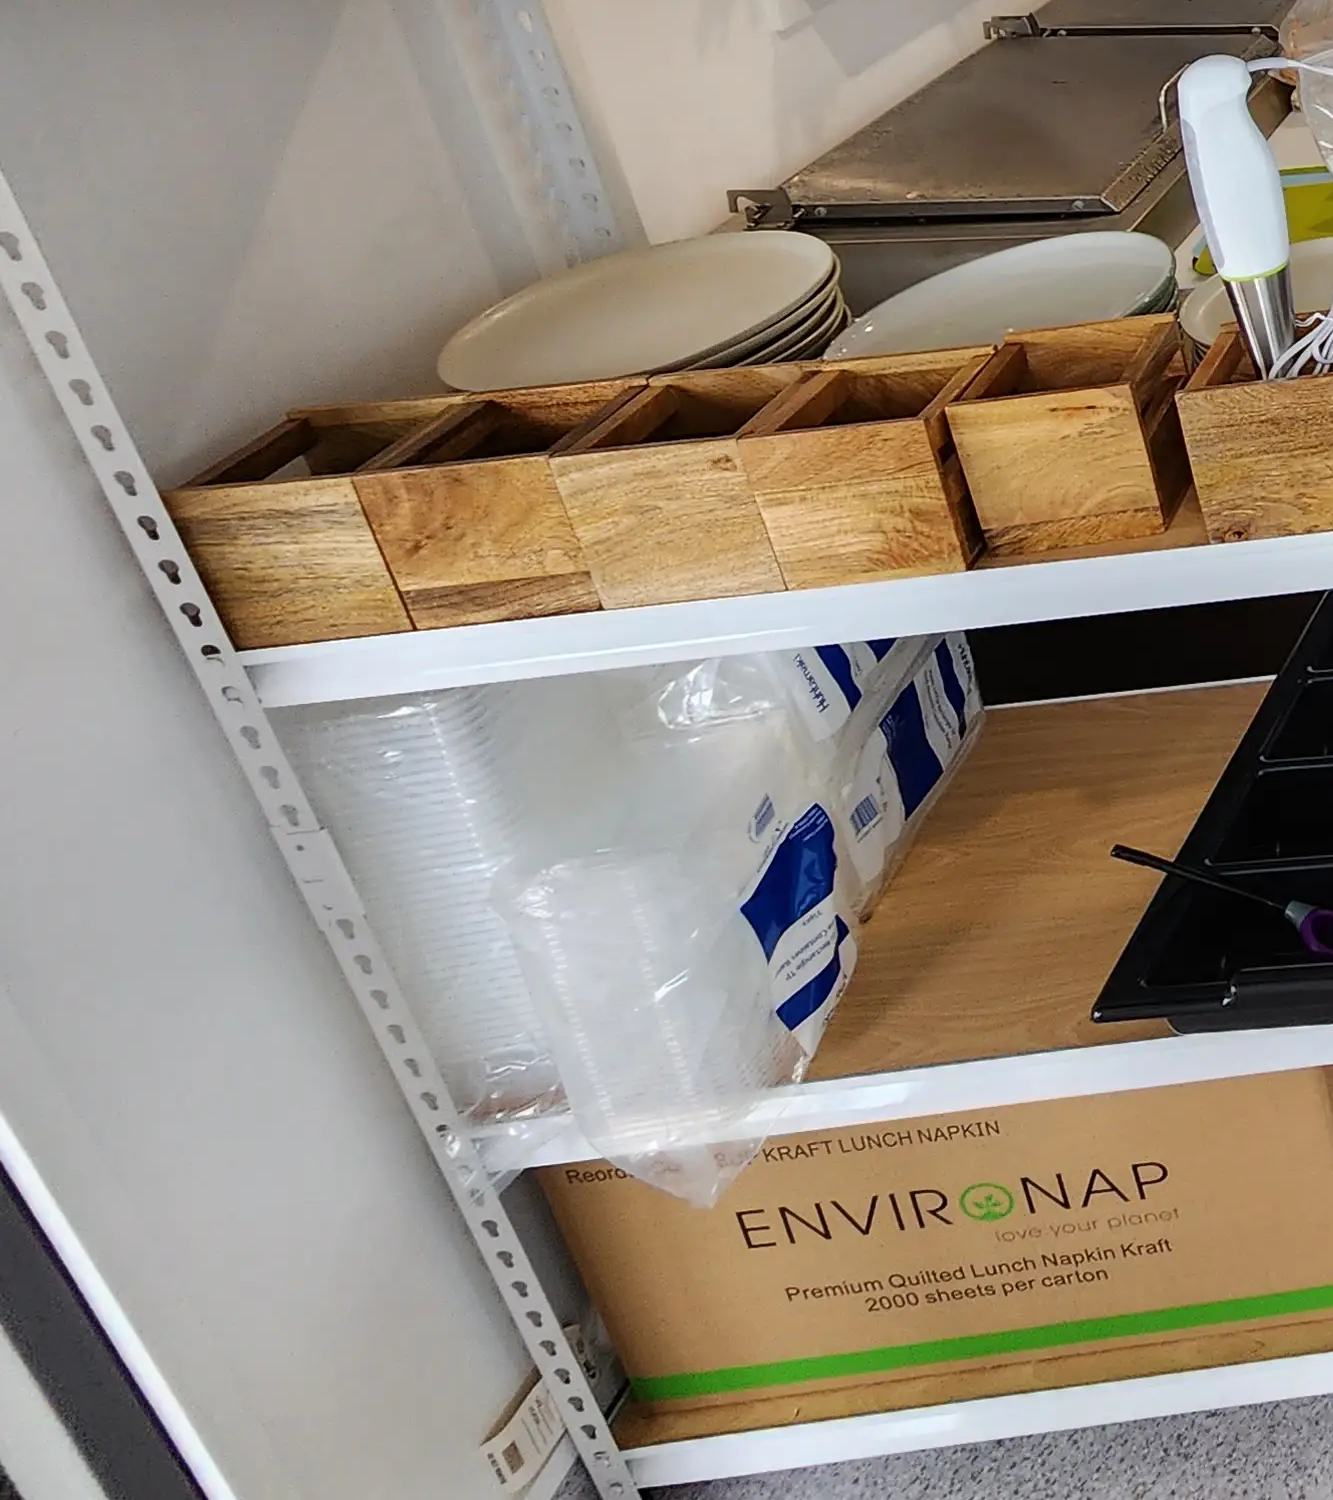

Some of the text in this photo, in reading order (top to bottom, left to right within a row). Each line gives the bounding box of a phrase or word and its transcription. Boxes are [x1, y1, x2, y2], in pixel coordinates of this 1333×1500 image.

[761, 1139, 834, 1164] KRAFT
[838, 1131, 914, 1154] LUNCH
[917, 1120, 1001, 1145] NAPKIN
[994, 1208, 1181, 1244] love your planet
[785, 1237, 1174, 1301] Premium Quilted Lunch Napkin Kraft
[865, 1266, 1110, 1313] 2000 sheets per carton
